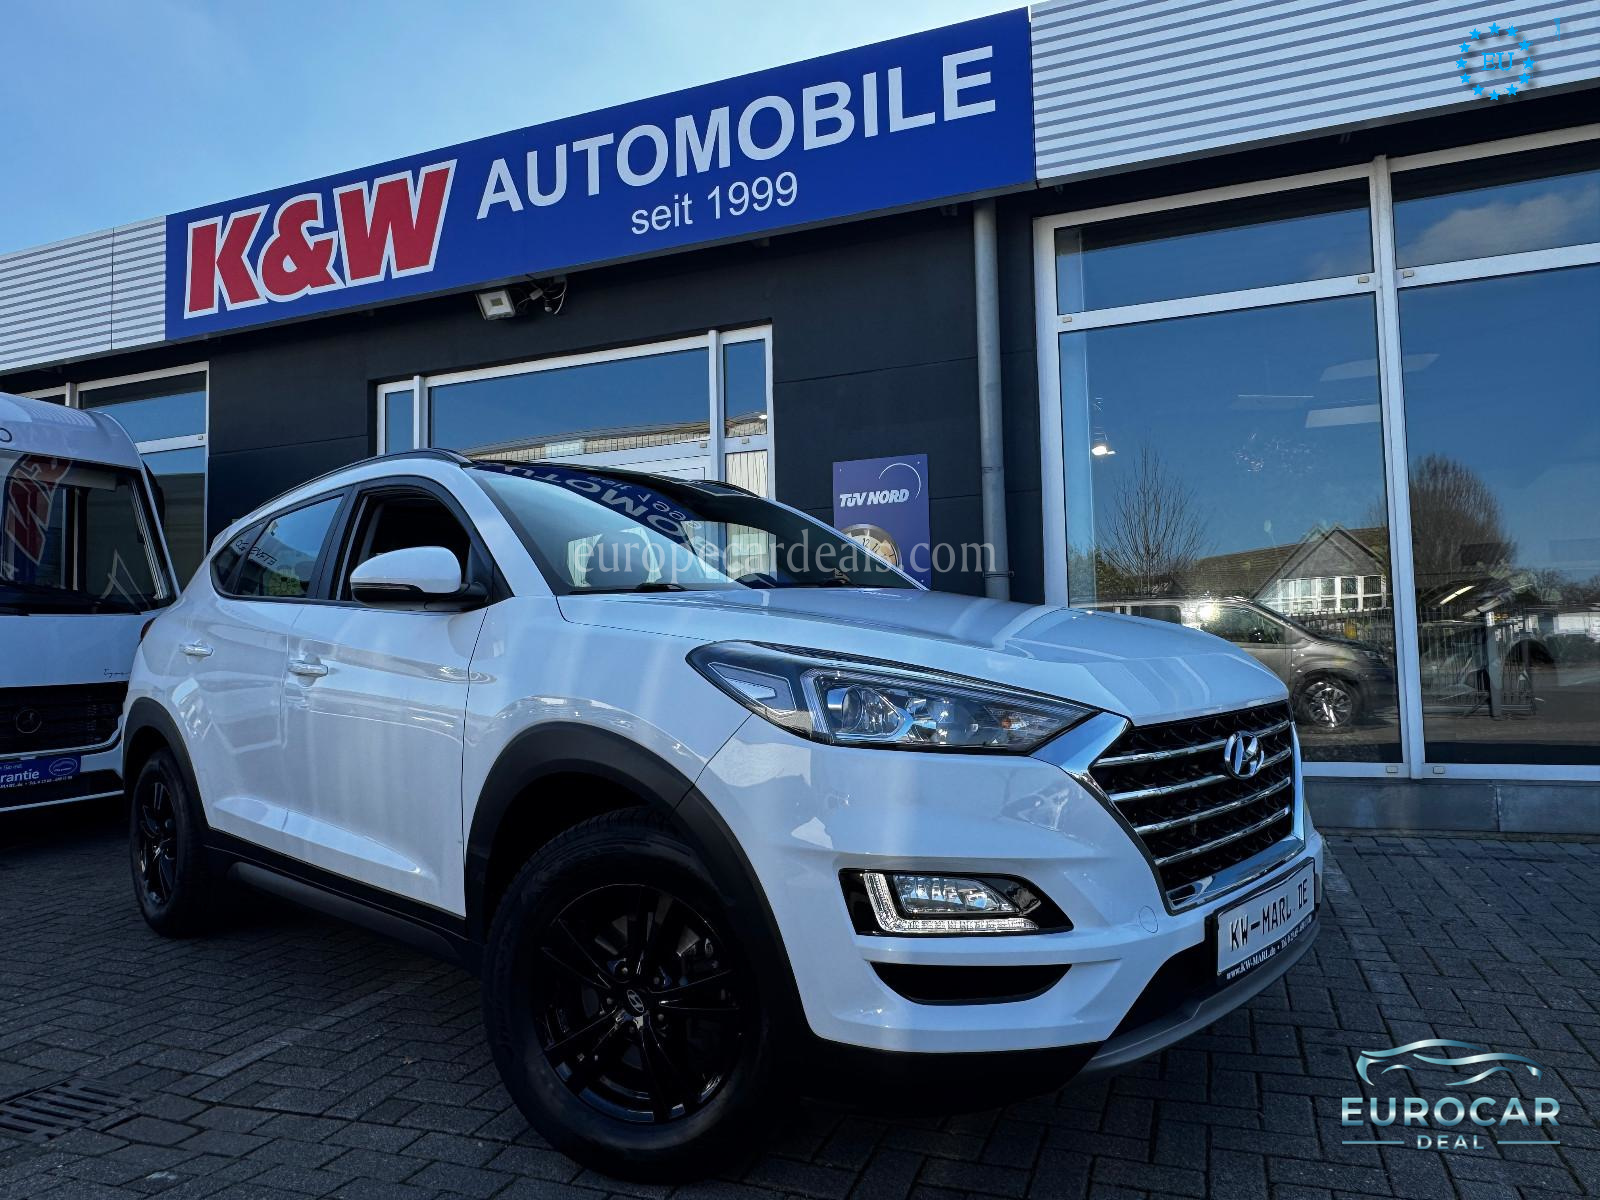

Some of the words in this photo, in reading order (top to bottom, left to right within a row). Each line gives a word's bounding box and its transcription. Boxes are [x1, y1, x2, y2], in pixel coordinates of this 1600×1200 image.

[184, 159, 457, 319] K&W
[477, 45, 997, 220] AUTOMOBILE
[630, 193, 693, 235] seit
[707, 171, 798, 220] 1999
[866, 488, 910, 506] NORD
